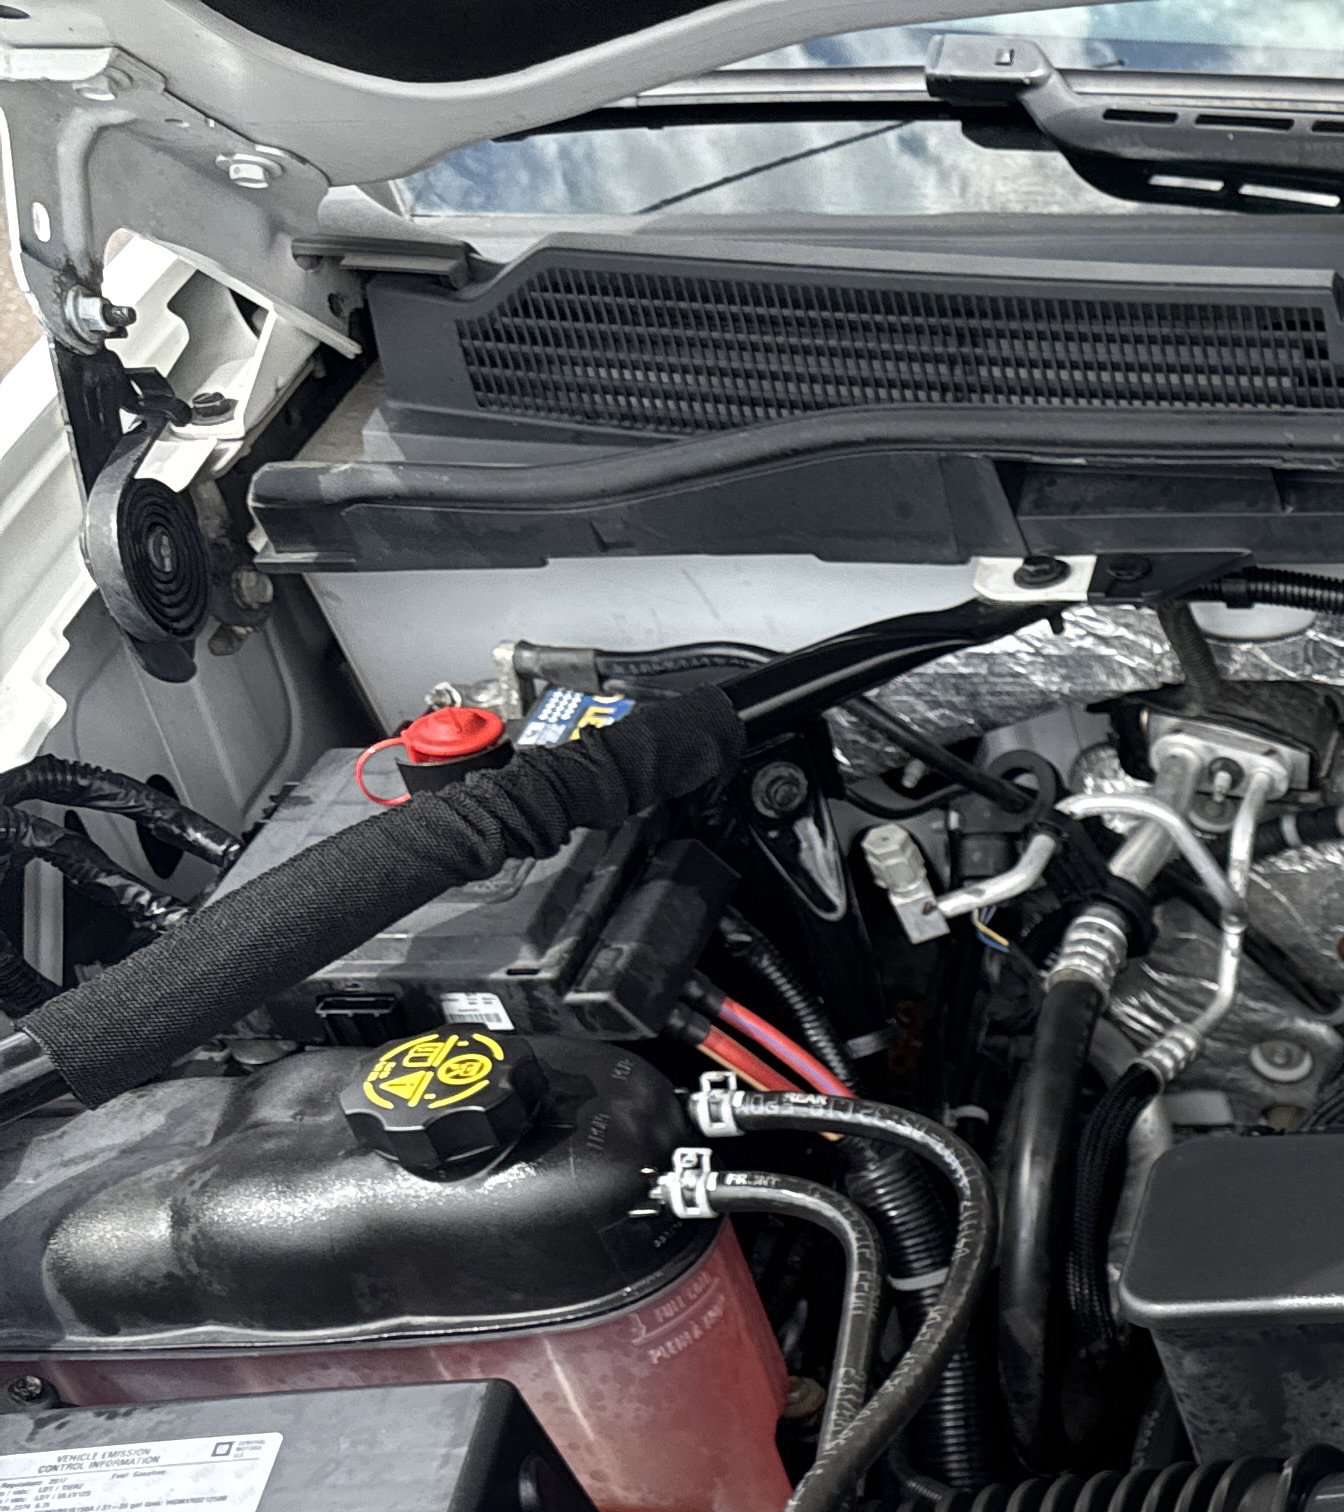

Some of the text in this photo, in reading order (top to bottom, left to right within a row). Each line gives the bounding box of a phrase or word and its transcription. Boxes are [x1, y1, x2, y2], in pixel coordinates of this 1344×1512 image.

[56, 1448, 151, 1463] VEHICLE EMISSION
[38, 1456, 160, 1474] CONTROL INFORMATION
